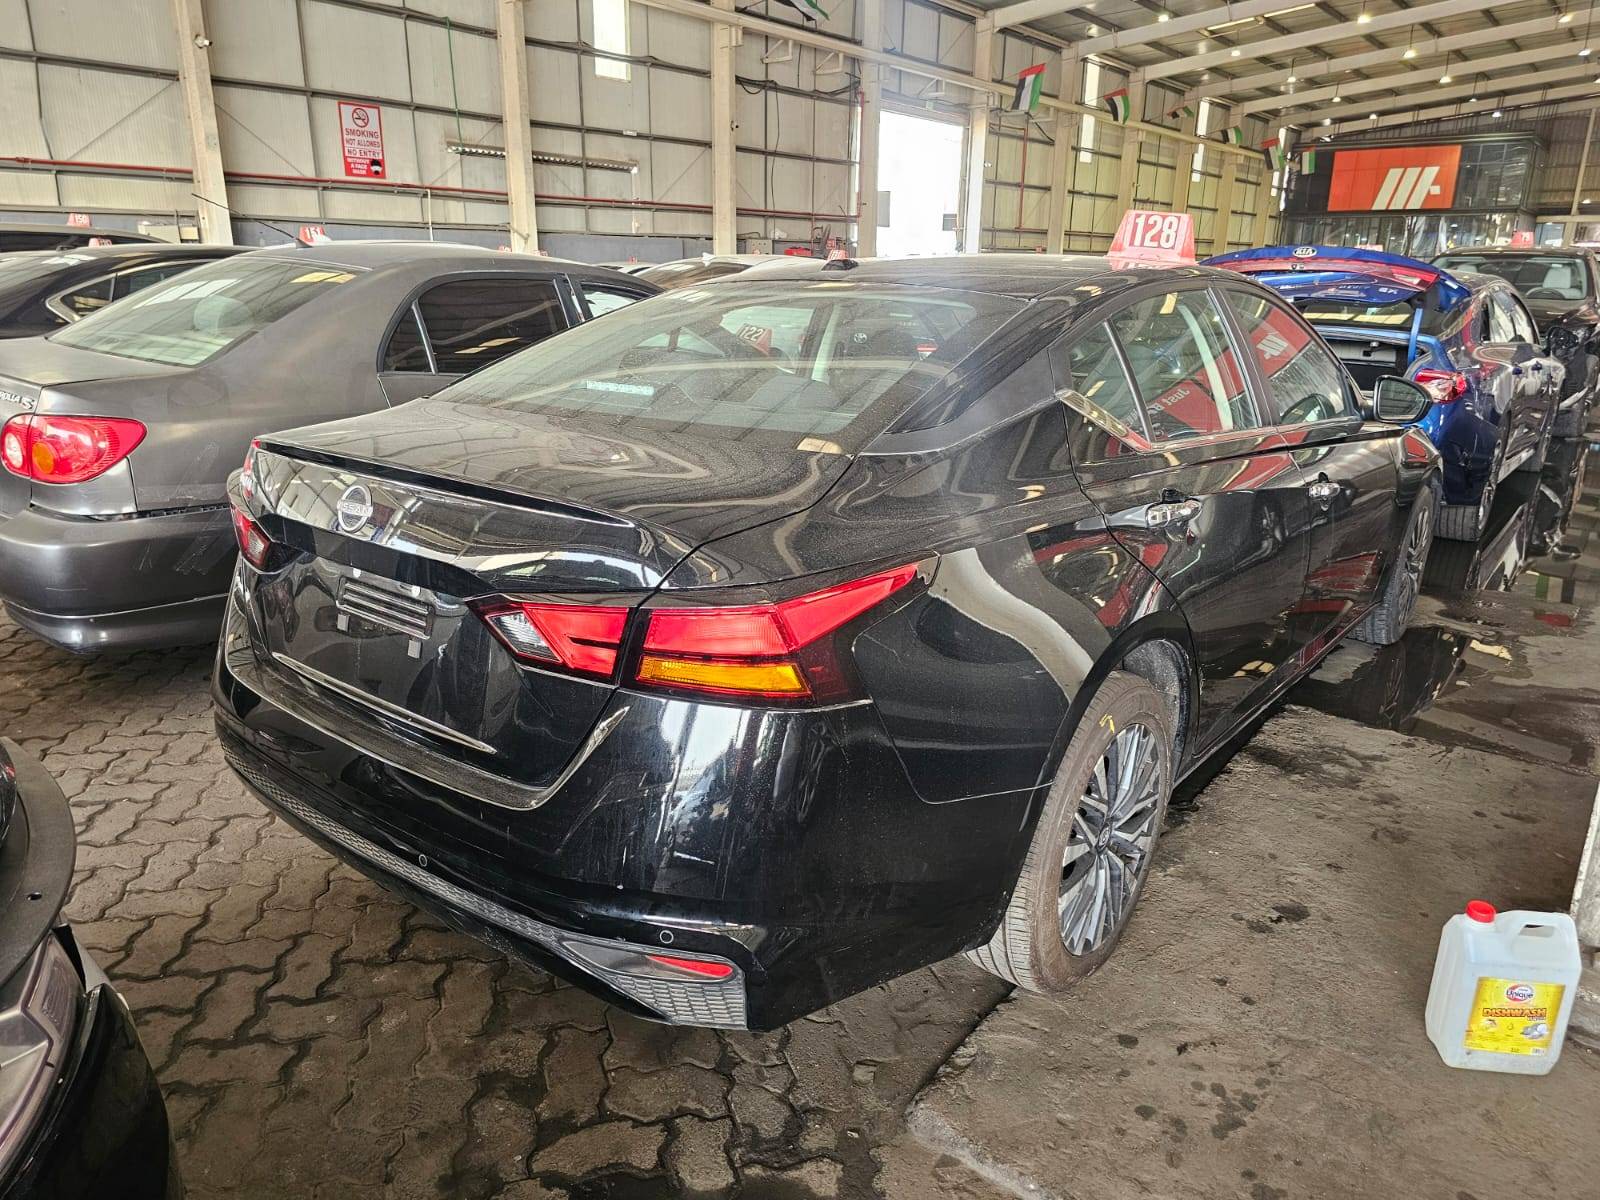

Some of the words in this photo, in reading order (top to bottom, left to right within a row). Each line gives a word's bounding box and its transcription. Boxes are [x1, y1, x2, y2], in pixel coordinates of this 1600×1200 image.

[345, 128, 379, 139] SMOKING
[345, 138, 356, 146] NOT
[357, 140, 380, 148] ALLOWED
[359, 150, 380, 158] ENTRY
[1135, 214, 1179, 248] 128
[740, 326, 764, 342] 122
[1506, 989, 1533, 1001] Unique
[1482, 1007, 1547, 1018] DISHWASH
